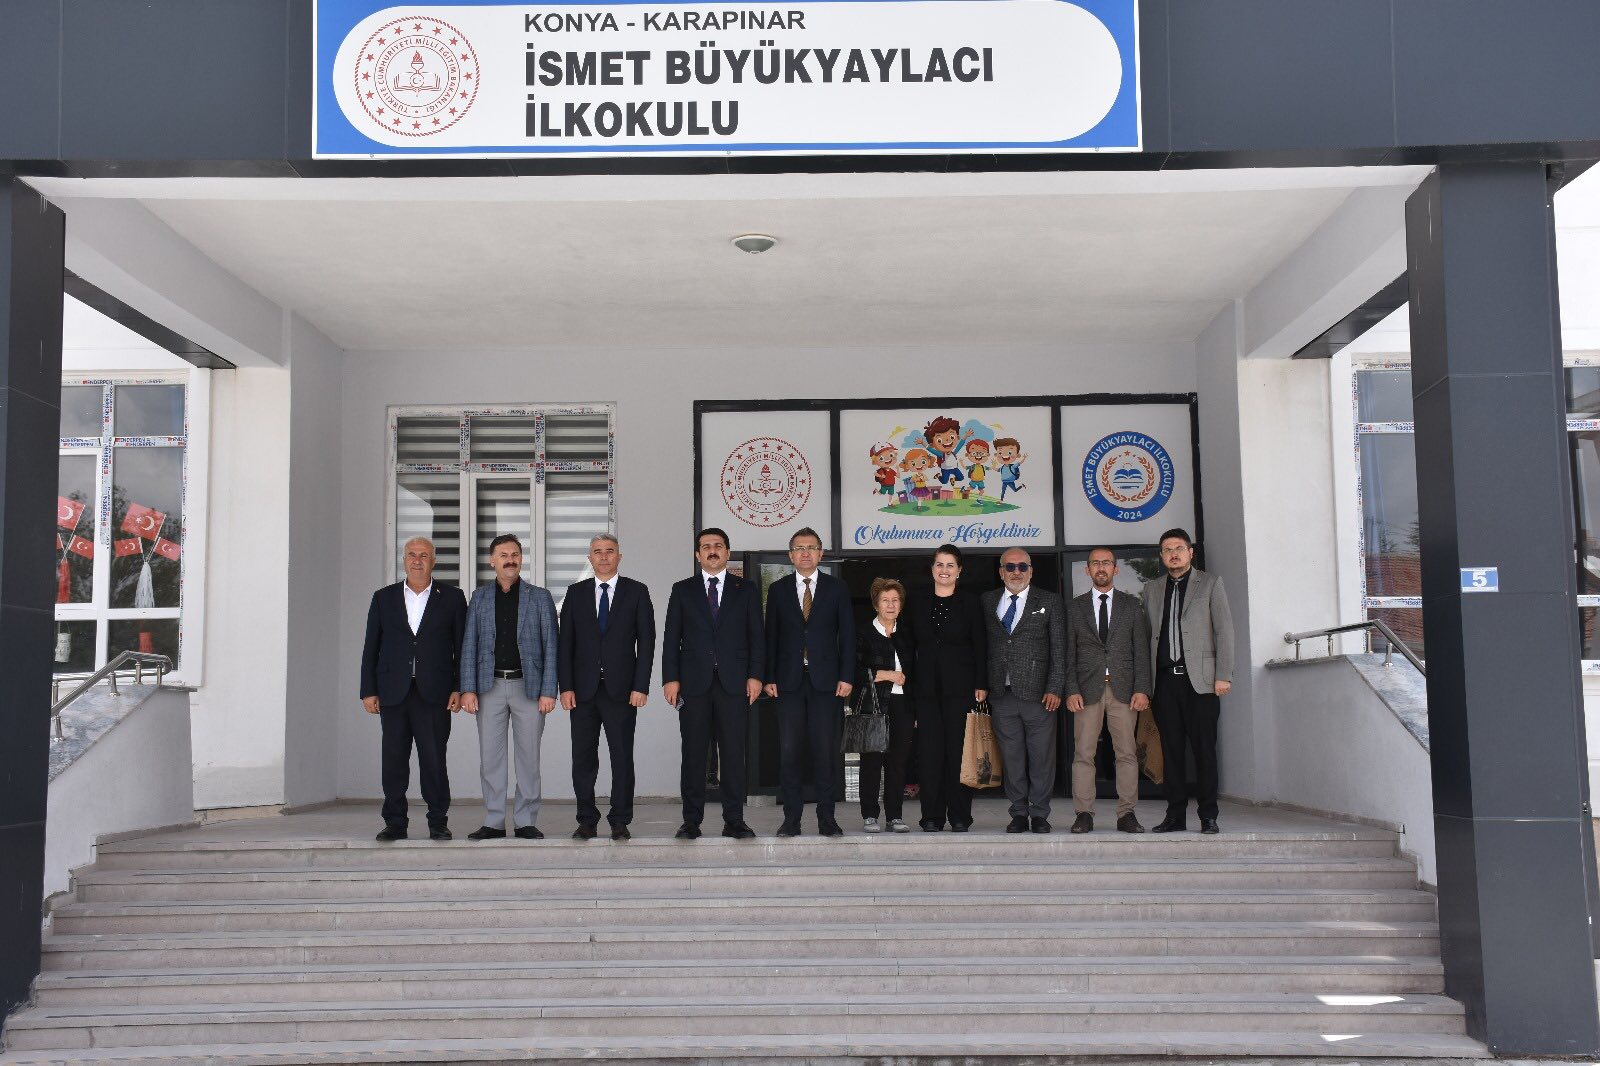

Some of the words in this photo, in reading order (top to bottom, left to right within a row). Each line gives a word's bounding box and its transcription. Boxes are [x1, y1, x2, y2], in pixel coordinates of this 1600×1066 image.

[524, 13, 619, 33] KONYA
[644, 10, 806, 32] KARAPINAR
[525, 42, 651, 86] İSMET
[666, 40, 994, 85] BÜYÜKYAYLACI
[525, 94, 739, 138] İLKOKULU
[1088, 434, 1156, 466] BÜYÜKYAYLACI
[1086, 467, 1098, 498] İSMET
[1153, 448, 1172, 497] İLKOKULU
[1116, 510, 1142, 520] 2024
[854, 524, 944, 546] Okulumuza
[948, 522, 1042, 544] Hoşgeldiniz
[1472, 570, 1487, 588] 5
